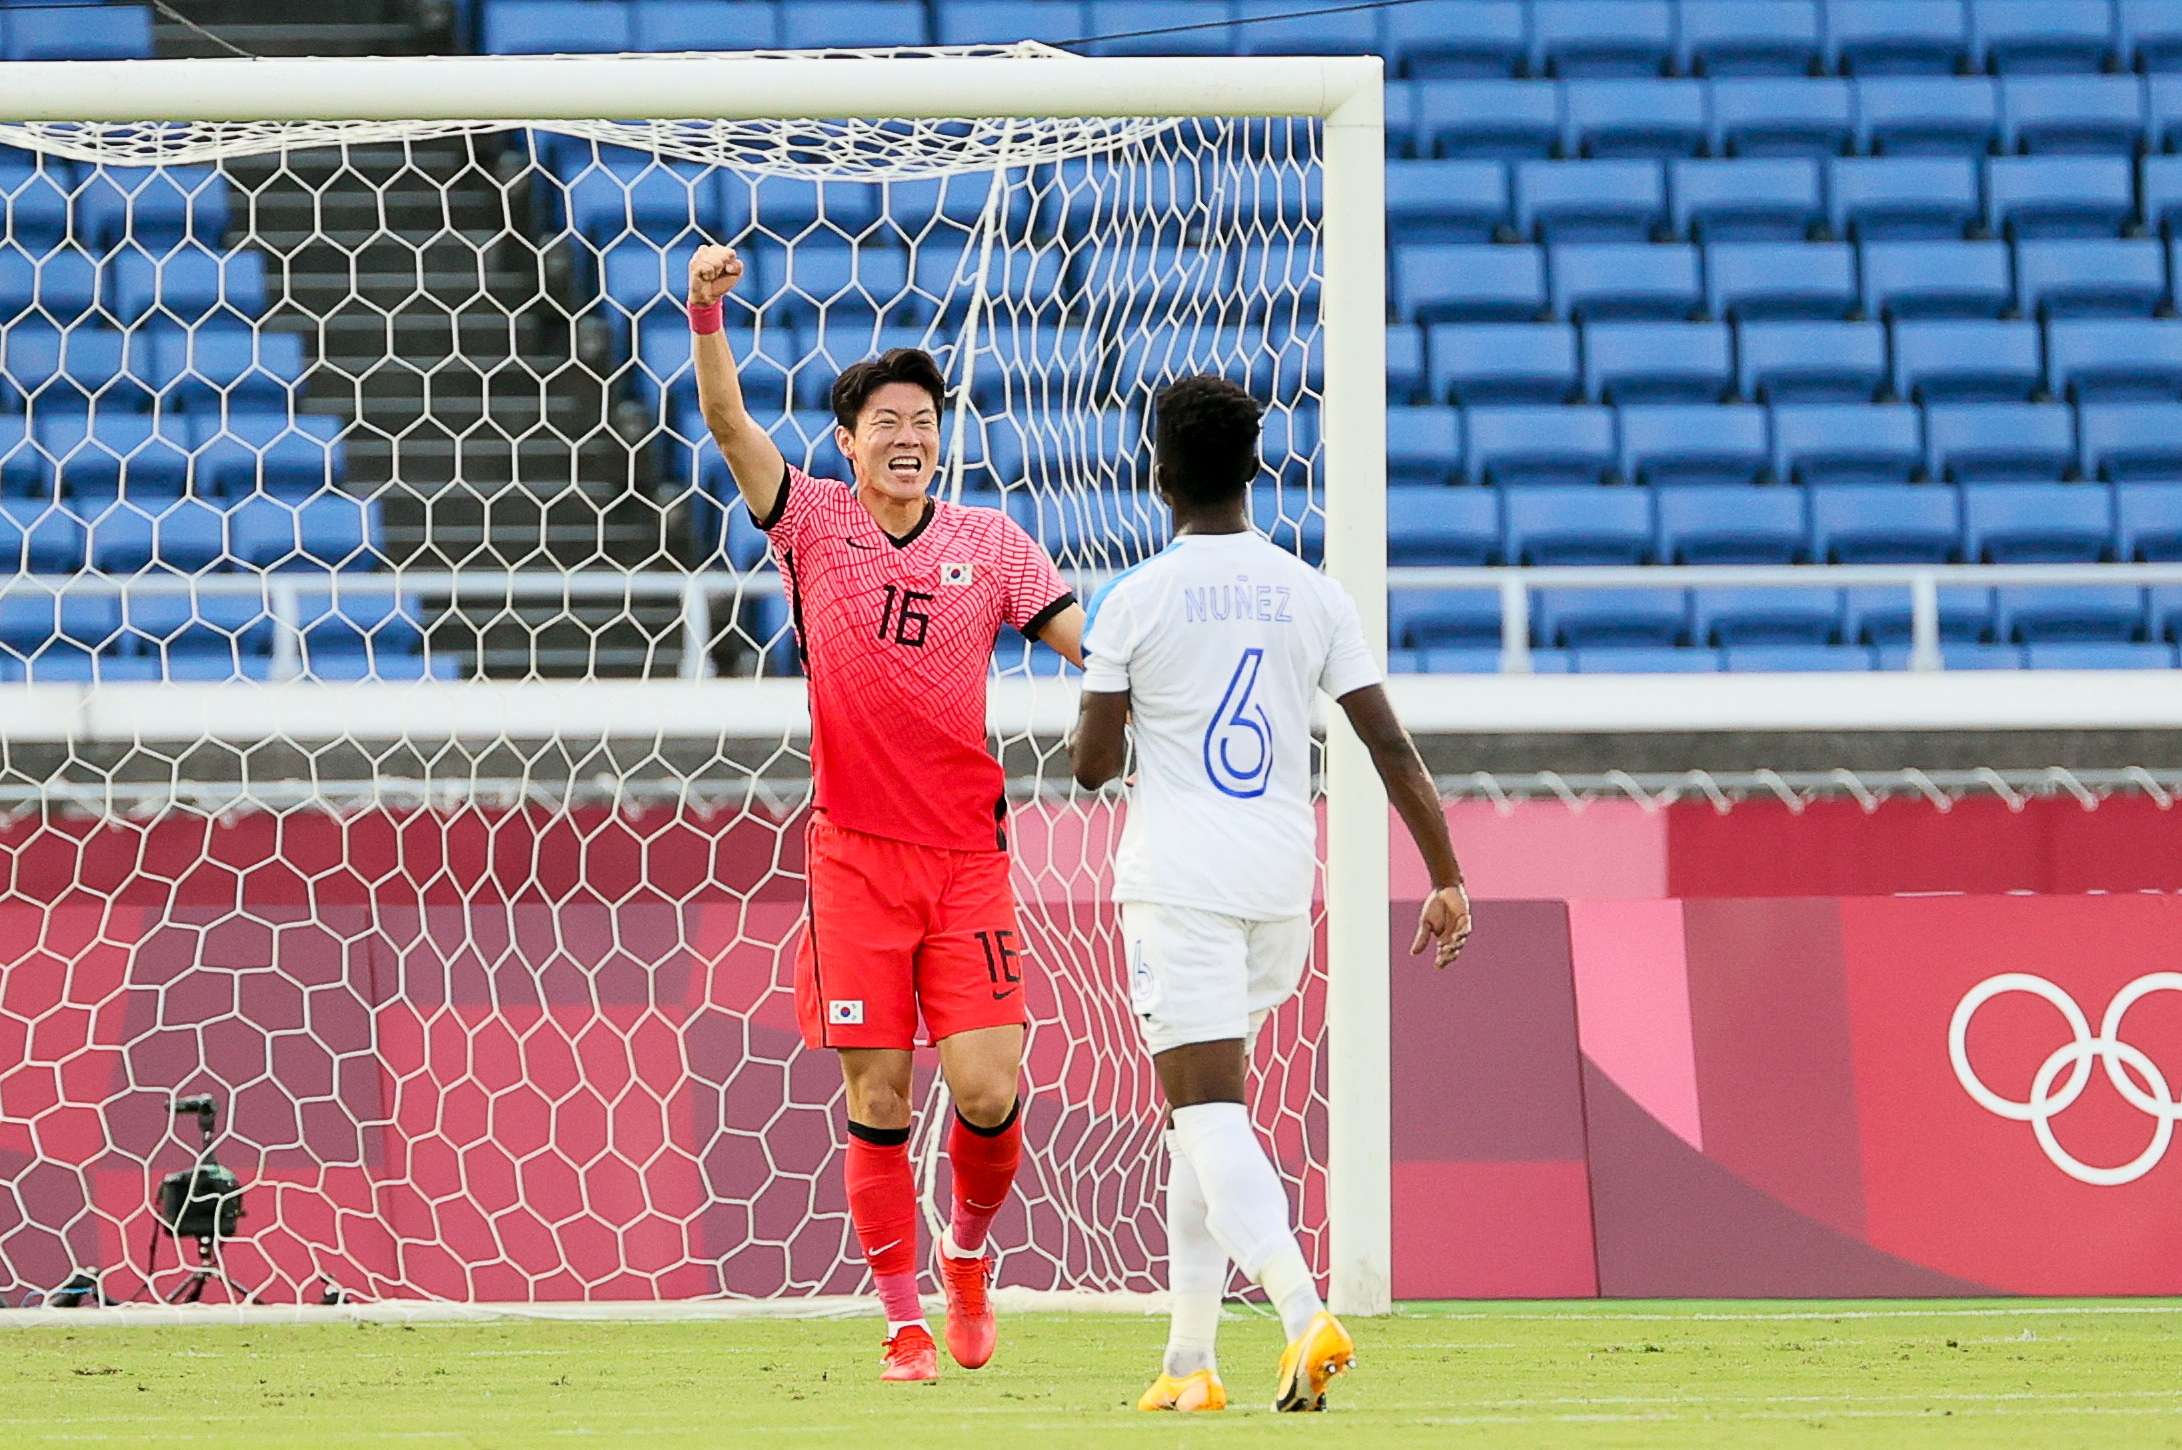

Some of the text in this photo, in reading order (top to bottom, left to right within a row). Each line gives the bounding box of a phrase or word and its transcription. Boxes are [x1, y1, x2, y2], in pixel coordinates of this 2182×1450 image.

[878, 584, 934, 648] 16
[1184, 575, 1293, 622] NUÑEZ
[1203, 648, 1273, 799] 6
[1132, 939, 1153, 1001] 6
